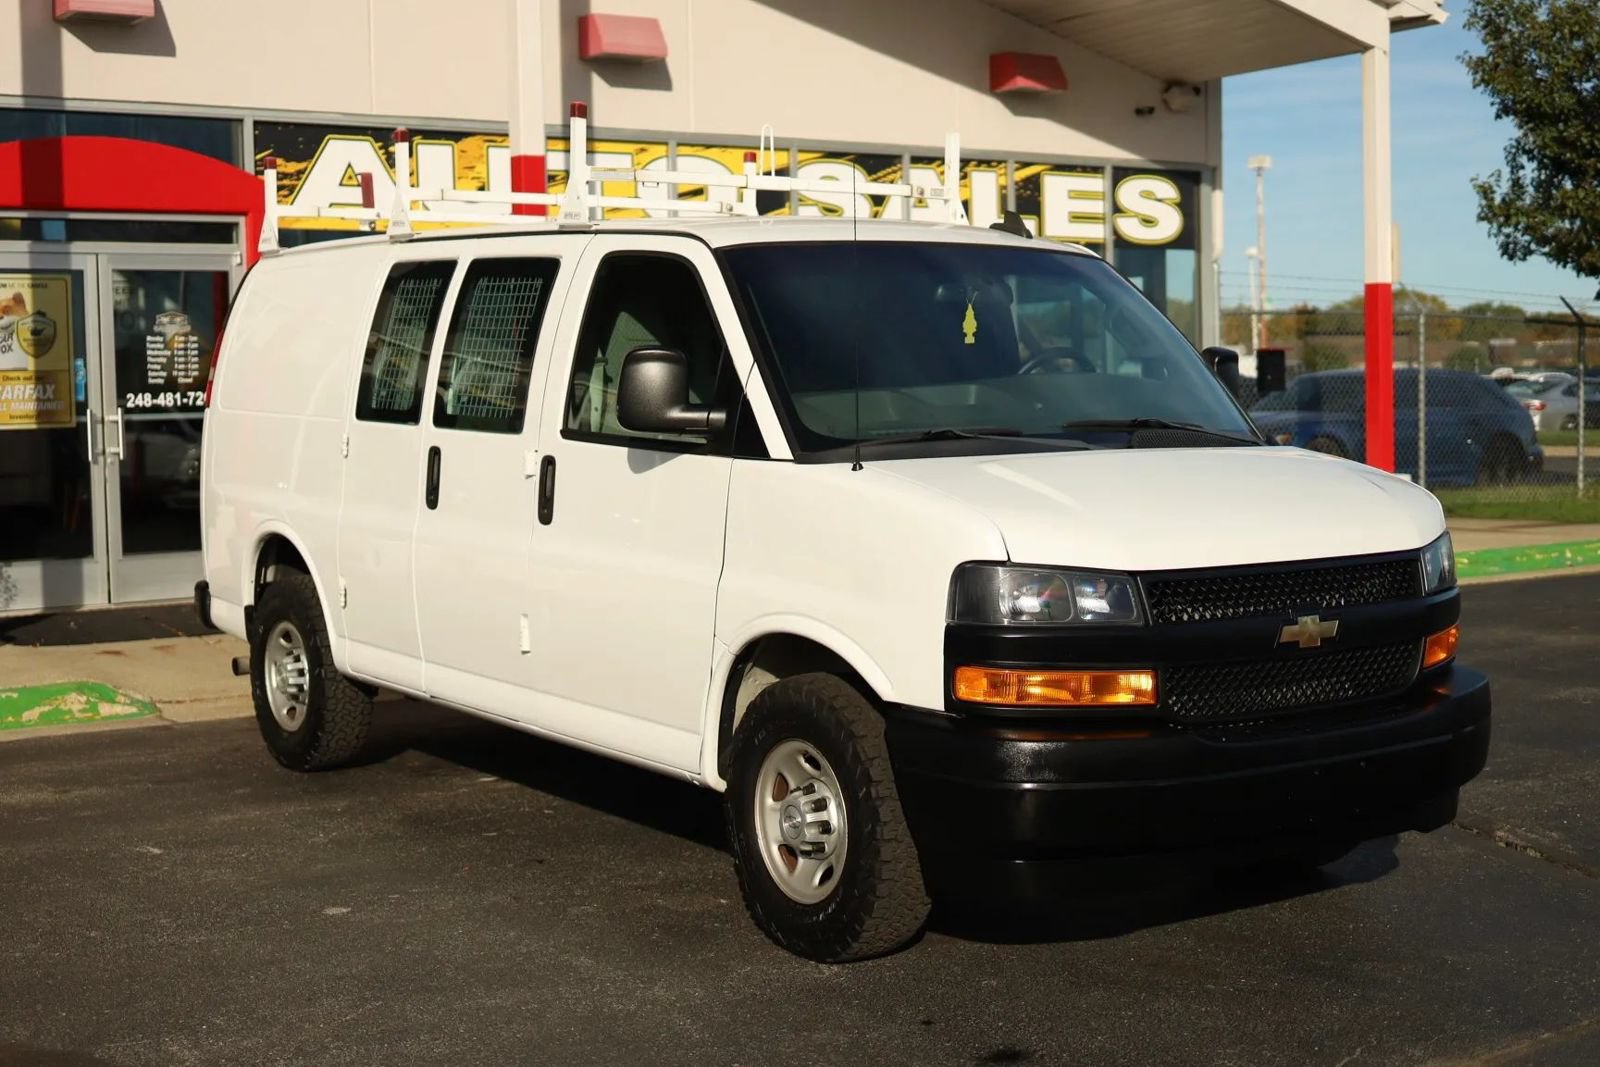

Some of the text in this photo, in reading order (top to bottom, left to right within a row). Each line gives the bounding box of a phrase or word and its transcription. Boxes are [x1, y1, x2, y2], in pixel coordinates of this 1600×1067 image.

[283, 133, 1185, 245] AUTO SALES
[0, 383, 56, 400] ARFAX
[126, 391, 207, 408] 248-481-72
